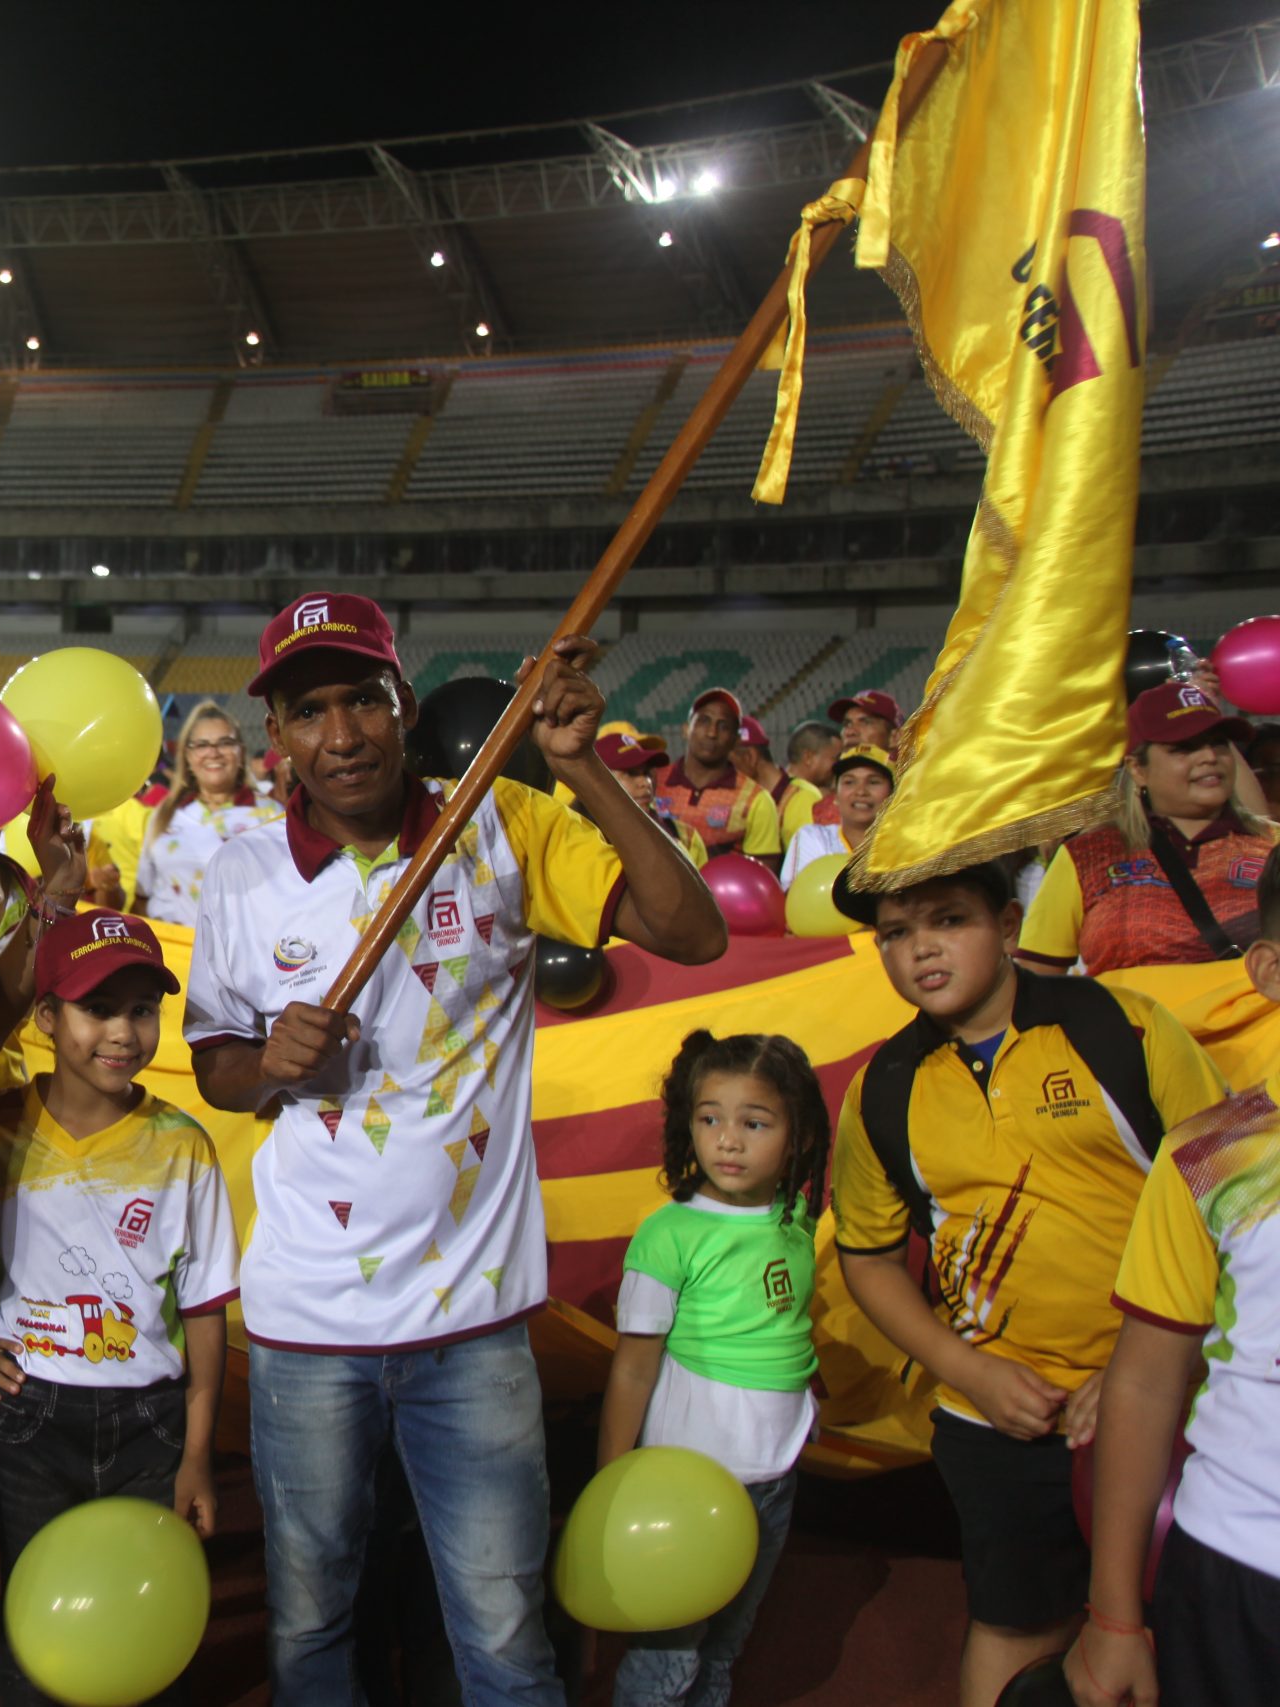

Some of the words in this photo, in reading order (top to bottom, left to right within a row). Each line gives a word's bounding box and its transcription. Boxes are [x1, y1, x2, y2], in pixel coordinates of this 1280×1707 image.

[274, 624, 320, 656] FERROMINERA
[321, 622, 358, 634] ORINOCO
[69, 935, 122, 961] FERROMINERA
